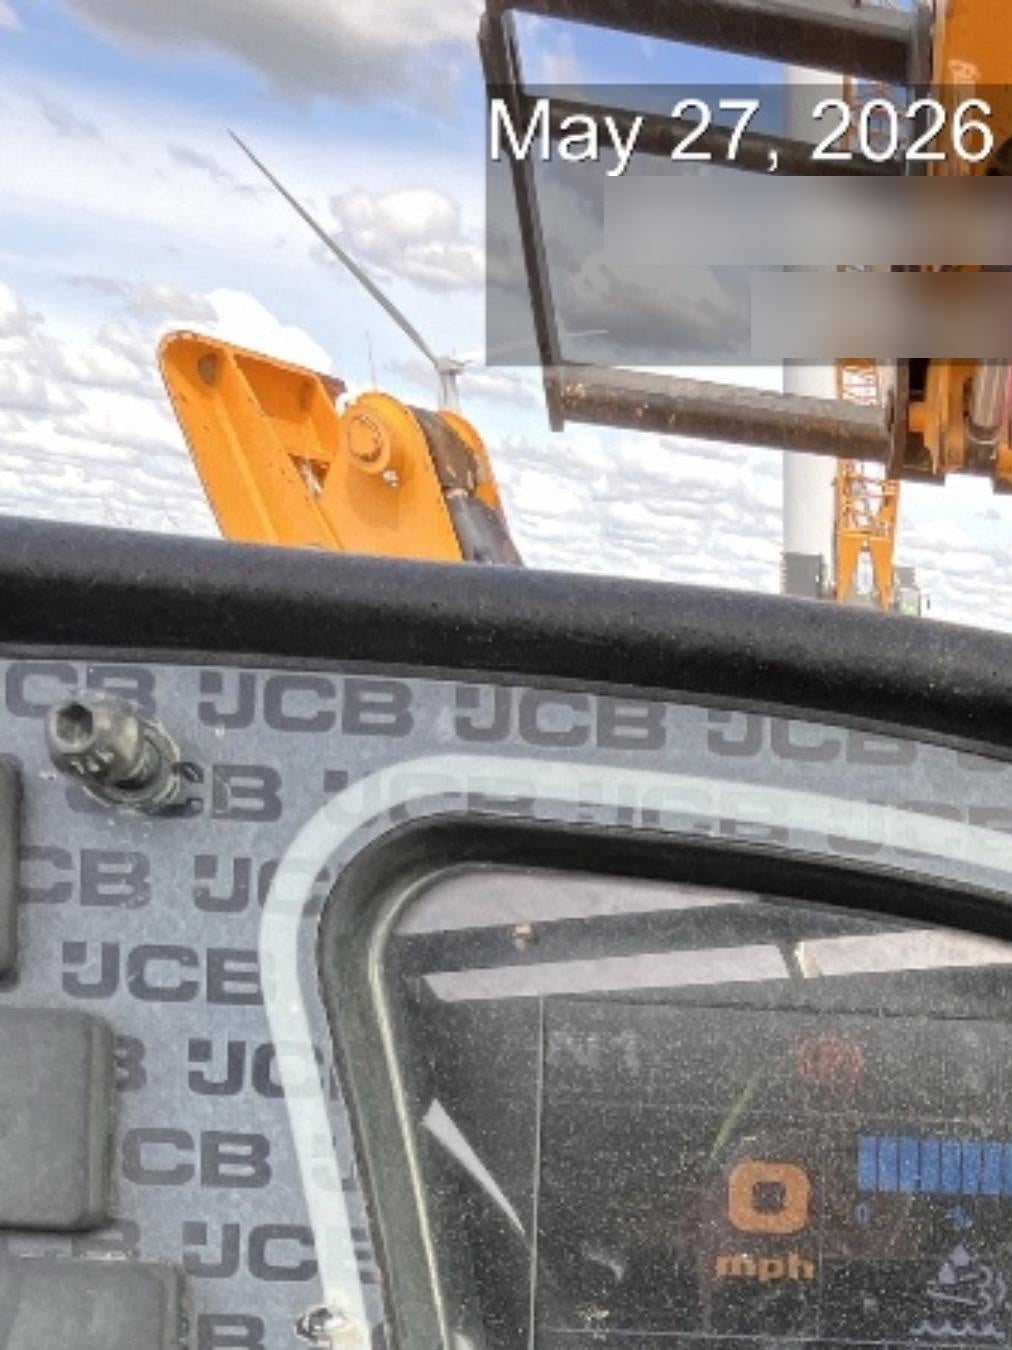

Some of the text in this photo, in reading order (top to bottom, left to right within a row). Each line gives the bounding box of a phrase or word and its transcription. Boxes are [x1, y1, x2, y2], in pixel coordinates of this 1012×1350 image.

[5, 661, 157, 720] CB
[198, 670, 415, 738] JCB
[454, 685, 668, 750] JCB
[18, 846, 152, 909] CB
[121, 1127, 273, 1188] CB
[727, 1160, 811, 1234] 0
[715, 1251, 816, 1285] mph
